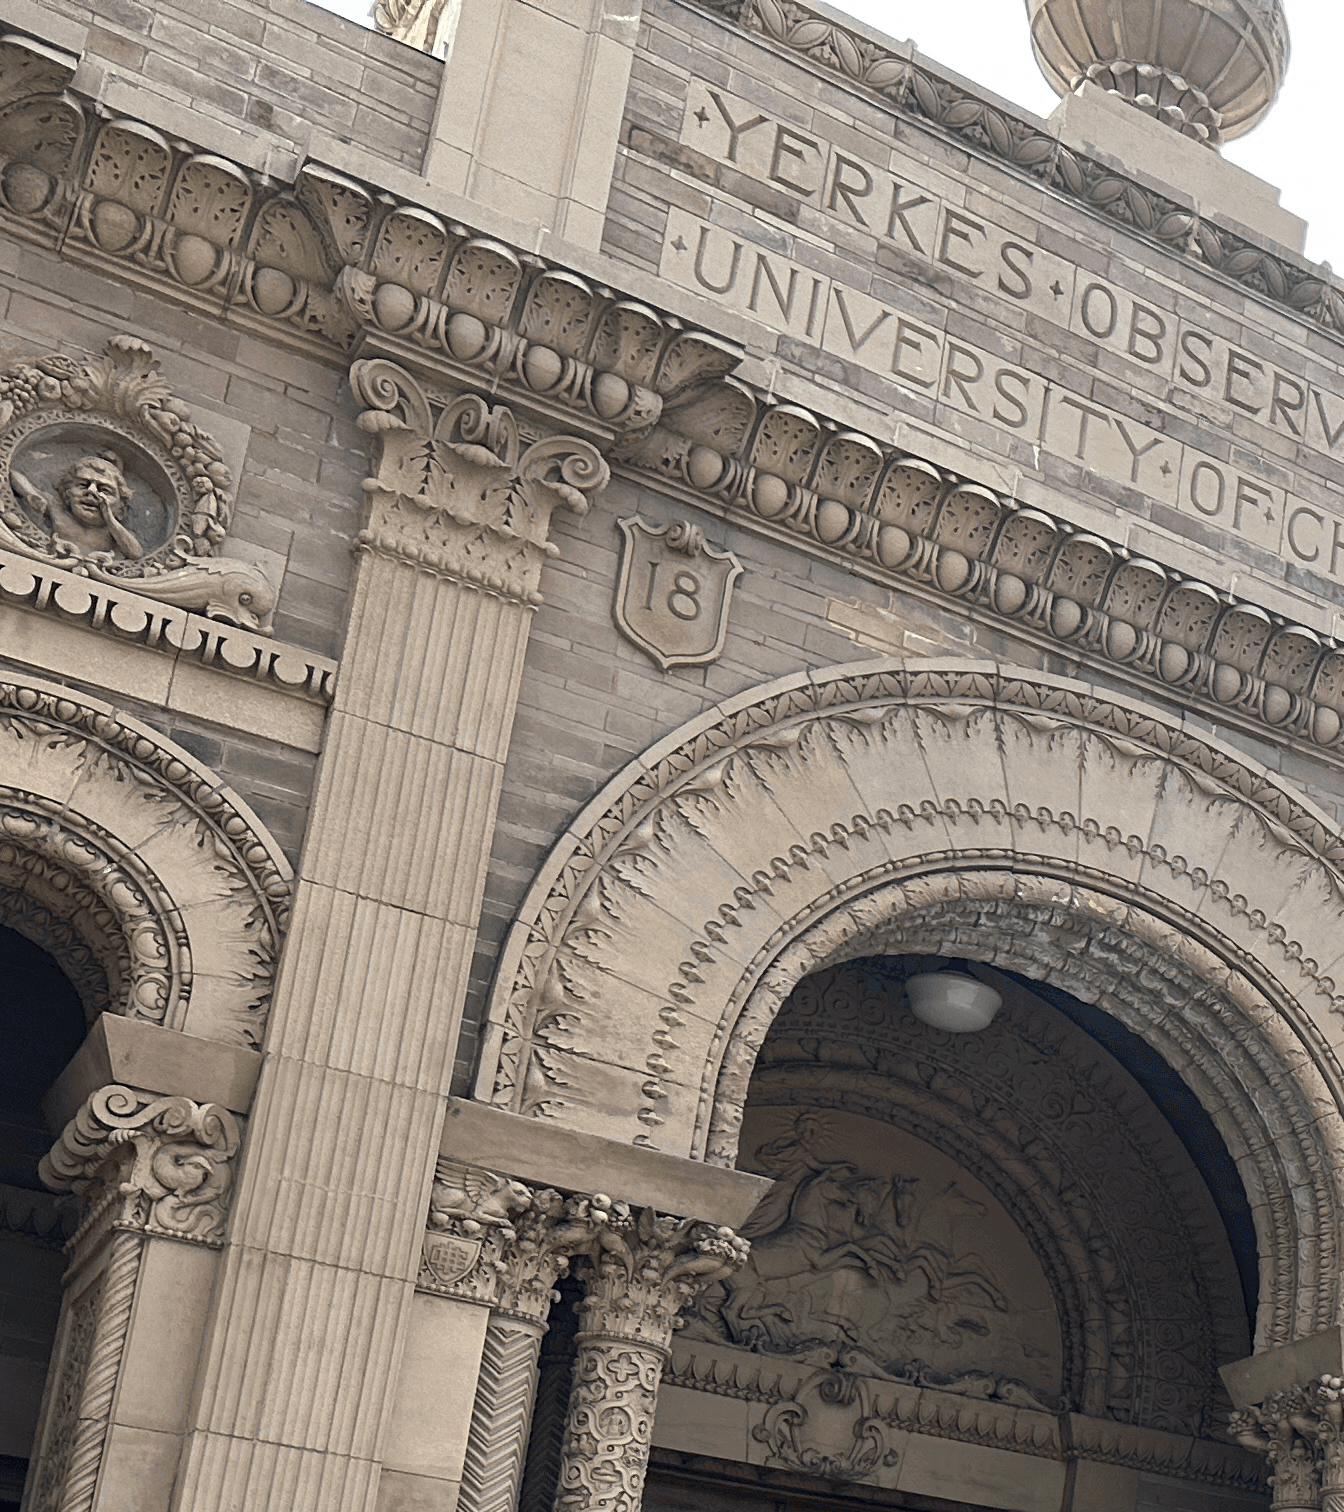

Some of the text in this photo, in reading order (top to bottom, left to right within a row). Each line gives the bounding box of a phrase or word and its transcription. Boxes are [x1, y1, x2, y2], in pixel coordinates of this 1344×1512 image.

[707, 89, 1034, 300] YERKES
[693, 226, 1165, 483] UNIVERSITY
[1189, 460, 1274, 530] OF
[641, 560, 701, 621] 18
